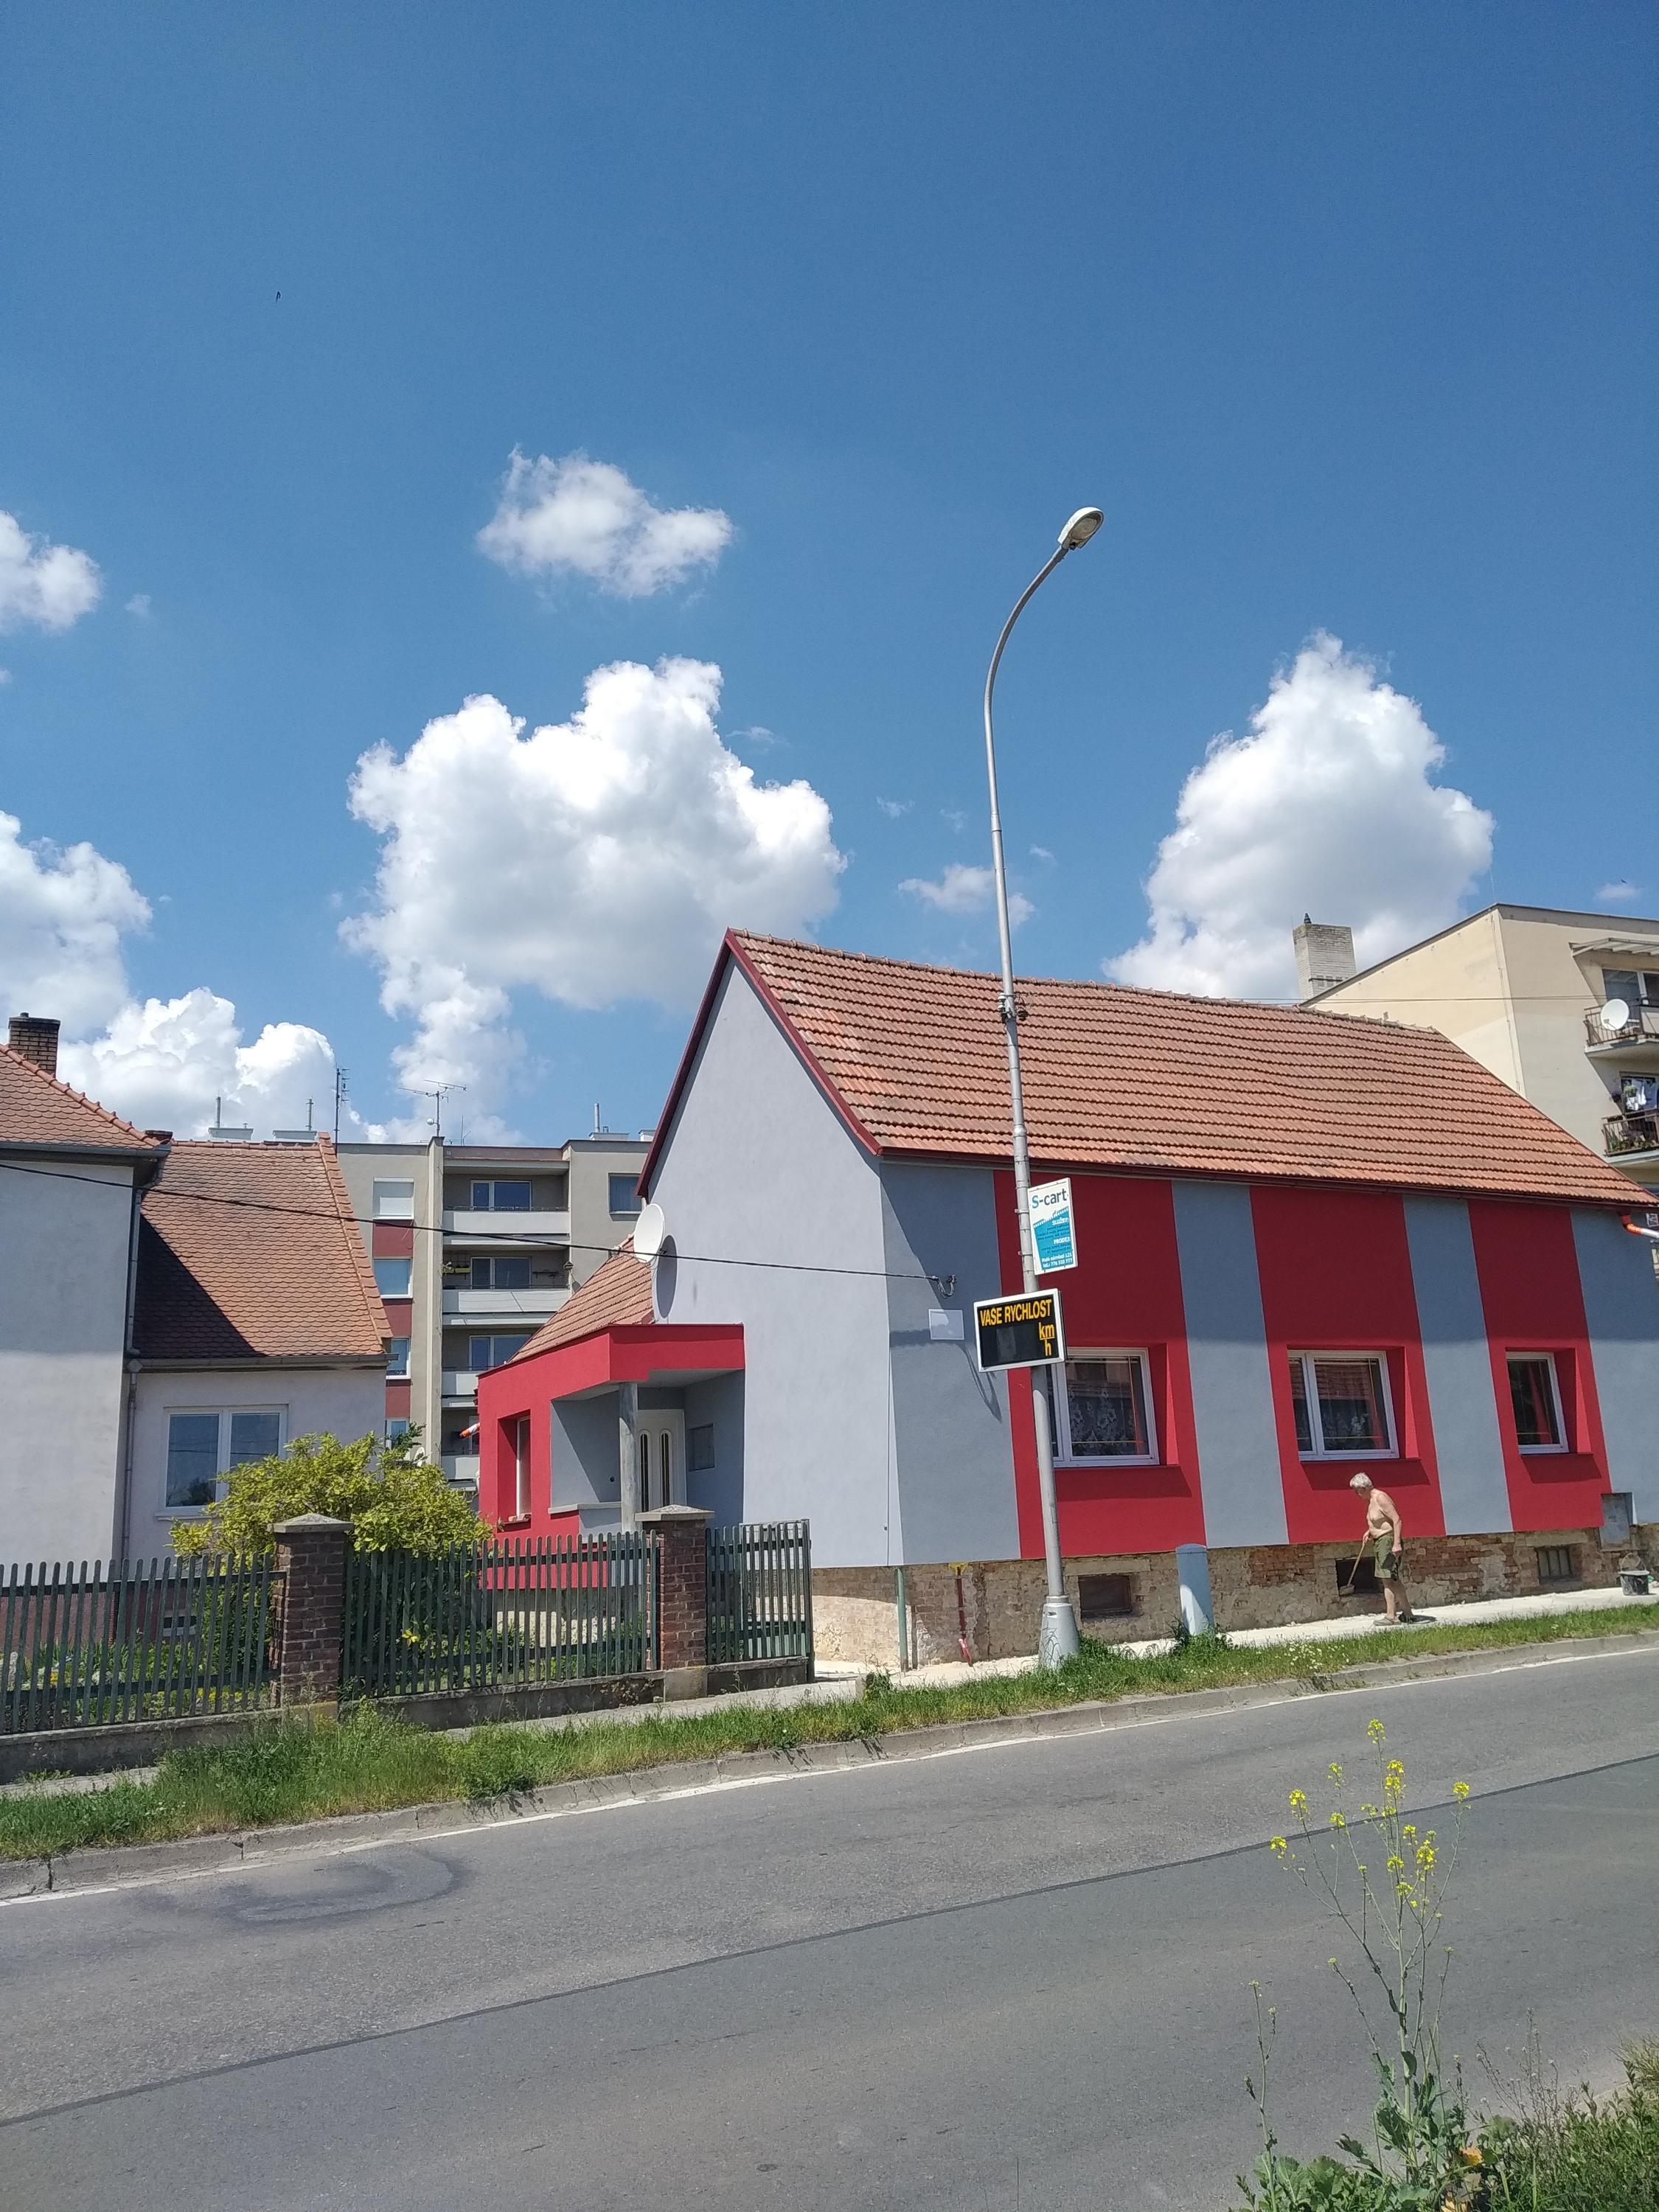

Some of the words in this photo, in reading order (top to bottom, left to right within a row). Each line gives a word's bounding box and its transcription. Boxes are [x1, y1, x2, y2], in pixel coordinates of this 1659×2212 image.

[1032, 1189, 1067, 1208] S-cart
[980, 1307, 1003, 1326] VASE
[1004, 1299, 1052, 1323] RYCHLOST
[1038, 1322, 1055, 1338] km
[1045, 1339, 1052, 1356] h
